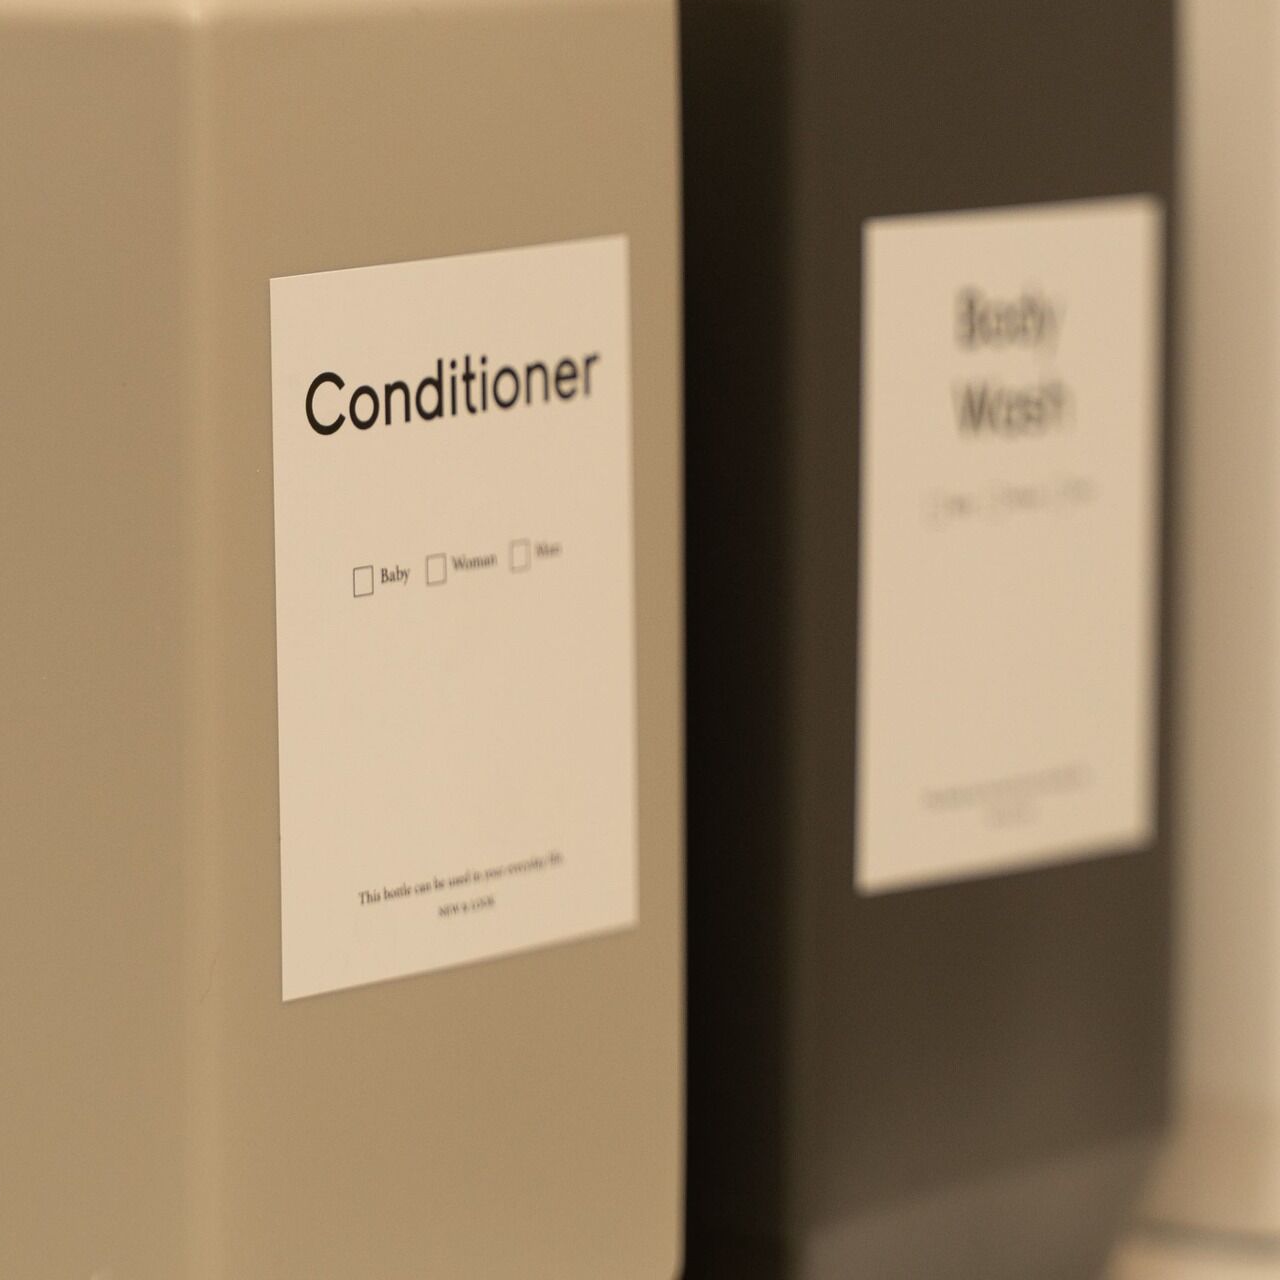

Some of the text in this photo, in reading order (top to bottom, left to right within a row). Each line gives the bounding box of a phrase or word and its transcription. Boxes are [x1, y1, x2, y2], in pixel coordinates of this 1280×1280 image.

[305, 353, 600, 436] Conditioner
[380, 565, 411, 586] Baby
[451, 553, 498, 572] Woman
[358, 889, 381, 906] This
[383, 882, 412, 901] bottle
[414, 881, 432, 895] can
